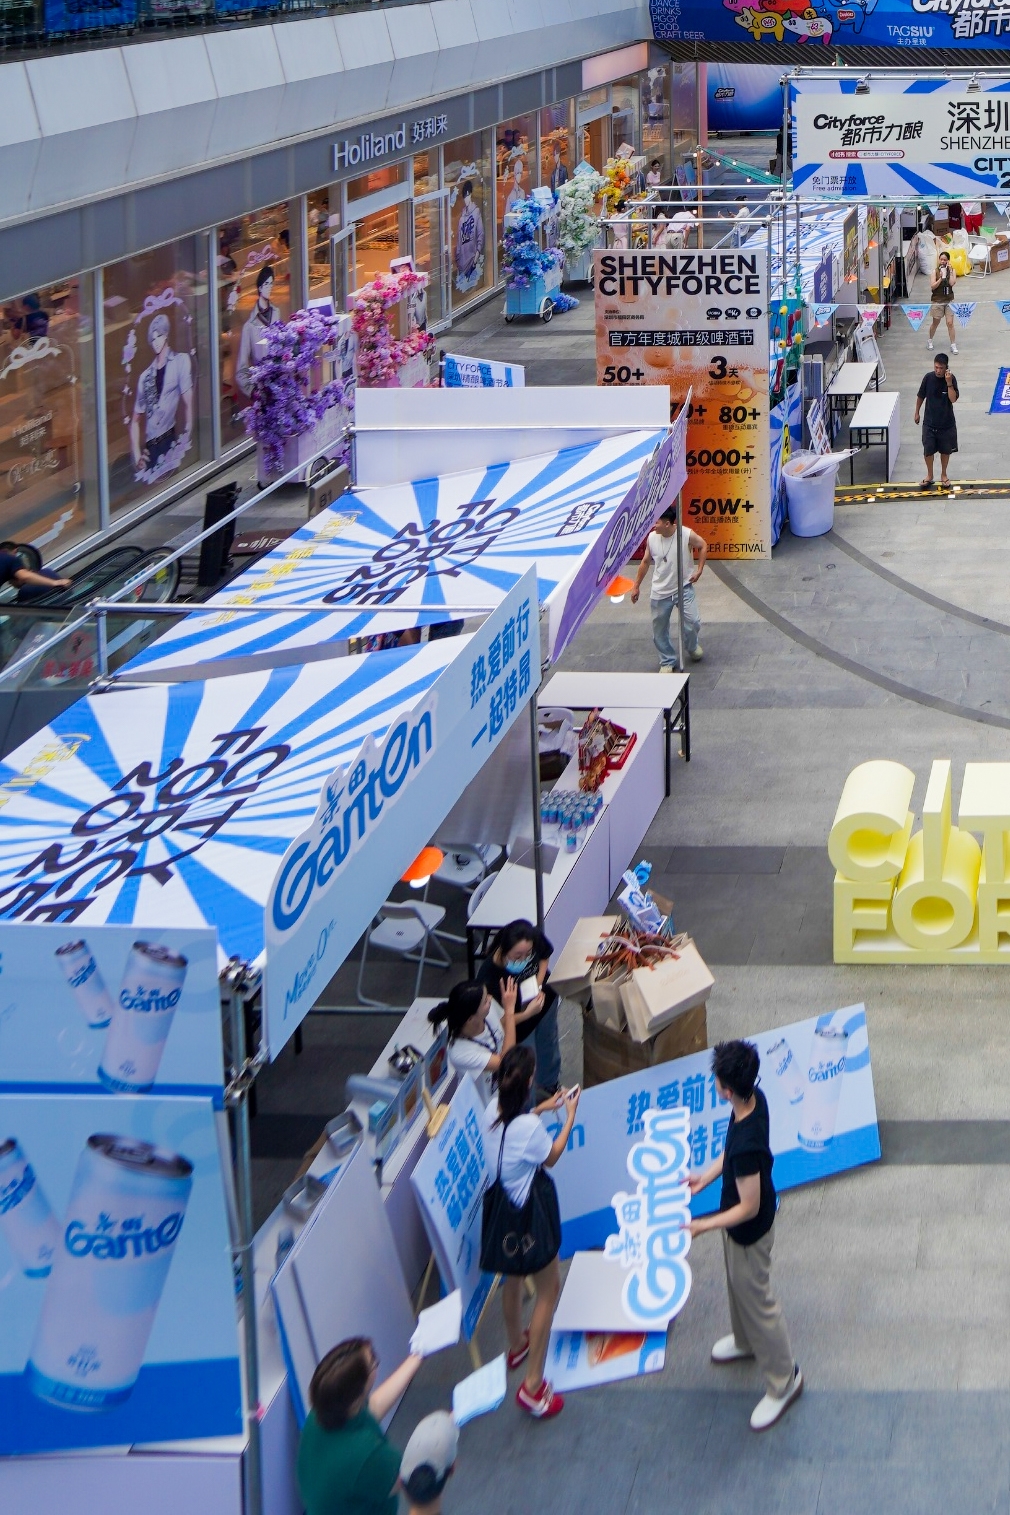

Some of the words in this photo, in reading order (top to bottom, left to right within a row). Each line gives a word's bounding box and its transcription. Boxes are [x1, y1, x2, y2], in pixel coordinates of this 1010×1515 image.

[651, 6, 682, 16] DRINKS
[652, 15, 678, 24] PIGGY
[653, 23, 679, 31] FOOD
[654, 31, 682, 40] CRAFT
[683, 31, 705, 40] BEER
[896, 38, 927, 46] 主办呈现
[412, 114, 448, 143] 好利来
[813, 113, 885, 132] Cityforce
[840, 121, 924, 147] 都市力酿
[333, 122, 406, 171] Holiland
[812, 176, 857, 185] 免门票开放
[600, 254, 757, 276] SHENZHEN
[599, 274, 761, 296] CITYFORCE
[609, 330, 754, 346] 官方年度城市级啤酒节
[447, 362, 466, 372] CITY
[465, 364, 492, 375] FORCE
[602, 365, 645, 383] 50+
[709, 355, 739, 380] 3天
[718, 406, 761, 424] 80+
[686, 449, 755, 467] 6000+
[319, 489, 334, 508] B1
[687, 498, 755, 516] 50W+
[356, 498, 497, 605] FORCE
[426, 507, 521, 578] CITY
[723, 543, 766, 553] FESTIVAL
[322, 520, 440, 604] 2025
[469, 597, 531, 710] 热爱前行
[470, 649, 531, 749] 一起特昂
[22, 725, 268, 924] FORCE
[124, 744, 292, 887] CITY
